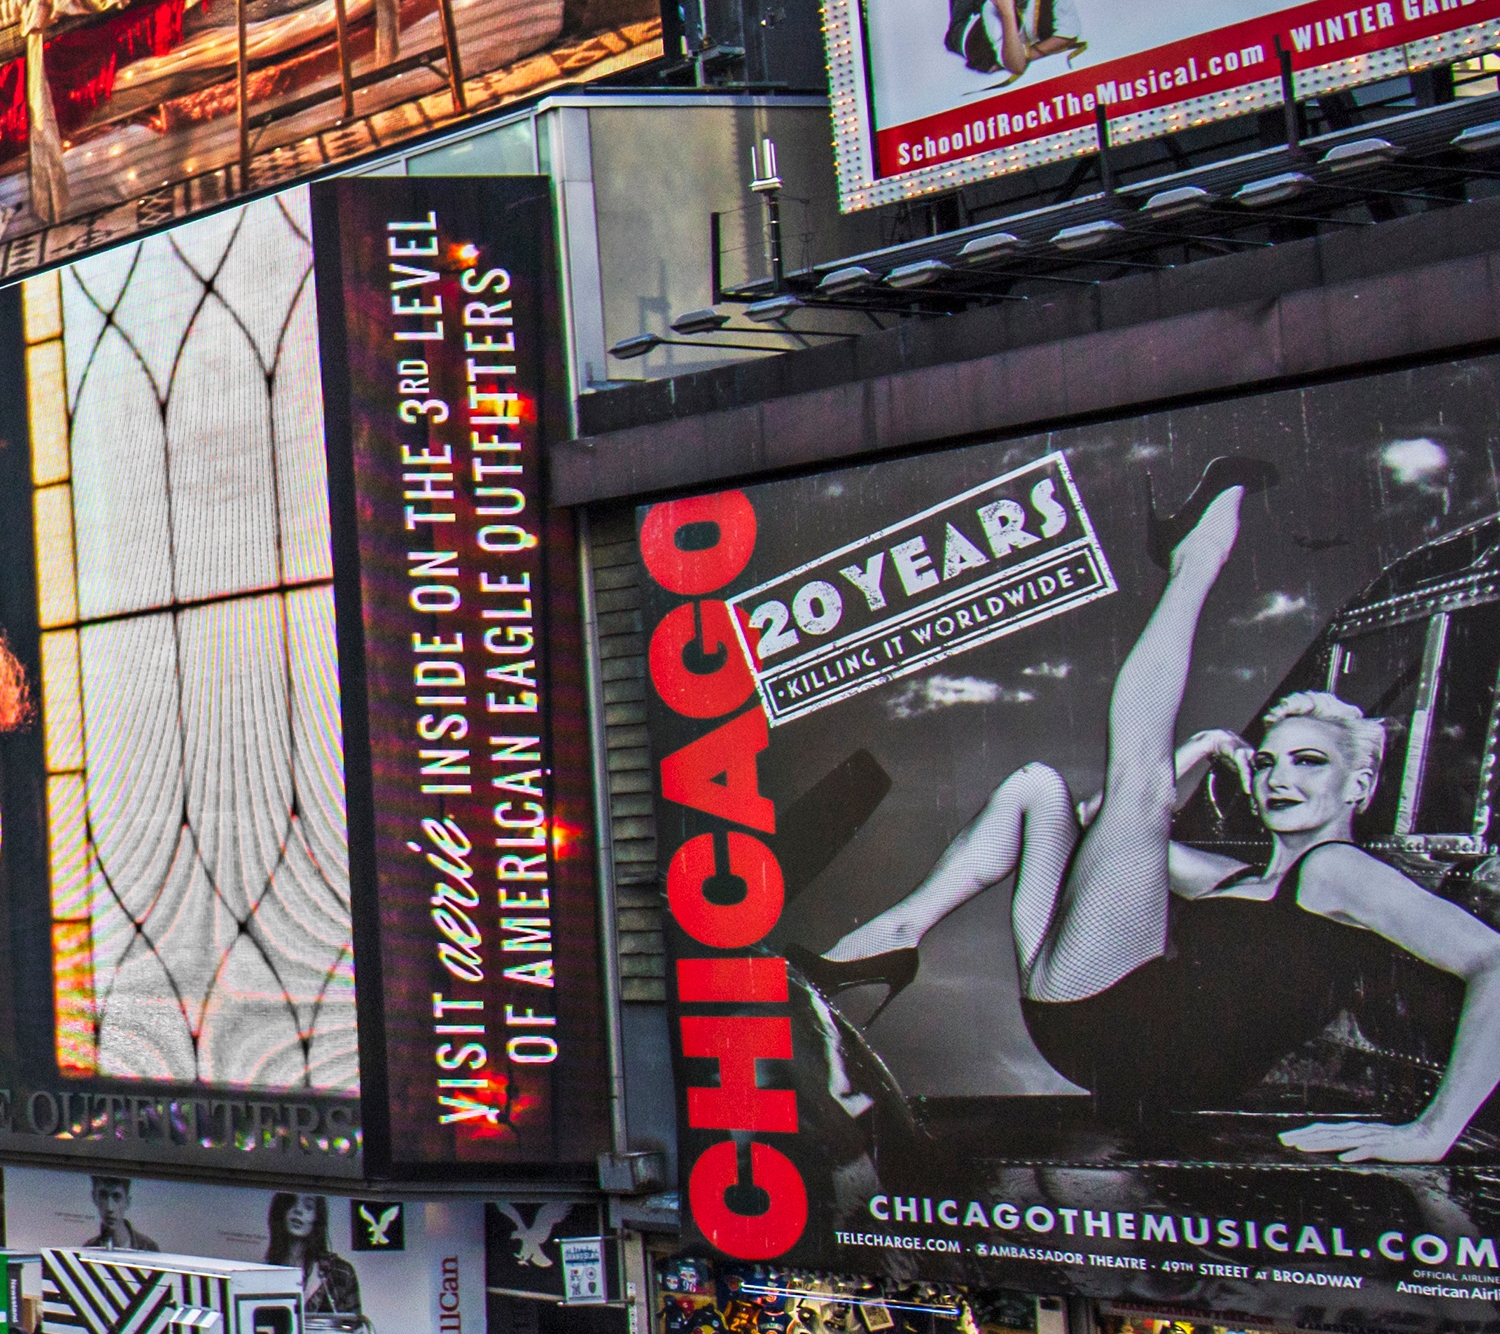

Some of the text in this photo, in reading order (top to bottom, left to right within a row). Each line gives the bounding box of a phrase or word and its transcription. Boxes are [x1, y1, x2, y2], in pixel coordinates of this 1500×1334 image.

[896, 40, 1265, 167] SchoolOfRockTheMusical.com
[388, 209, 441, 343] LEVEL
[402, 441, 456, 524] THE
[407, 551, 461, 612] ON
[747, 476, 1071, 662] 20 YEARS
[785, 566, 1076, 703] KILLING IT WORLDWIDE
[413, 632, 472, 794] INSIDE
[462, 268, 559, 1067] OF AMERICAN EAGLE OUTFITTERS
[407, 817, 484, 983] aerie
[640, 489, 808, 1261] CHICAGO
[437, 991, 499, 1125] VISIT
[835, 1231, 1363, 1289] TELECHARGE.COM AMBASSADOR THEATRE 49TH STREET BROADWAY
[868, 1194, 1500, 1268] CHICAGOTHEMUSICAL.COM
